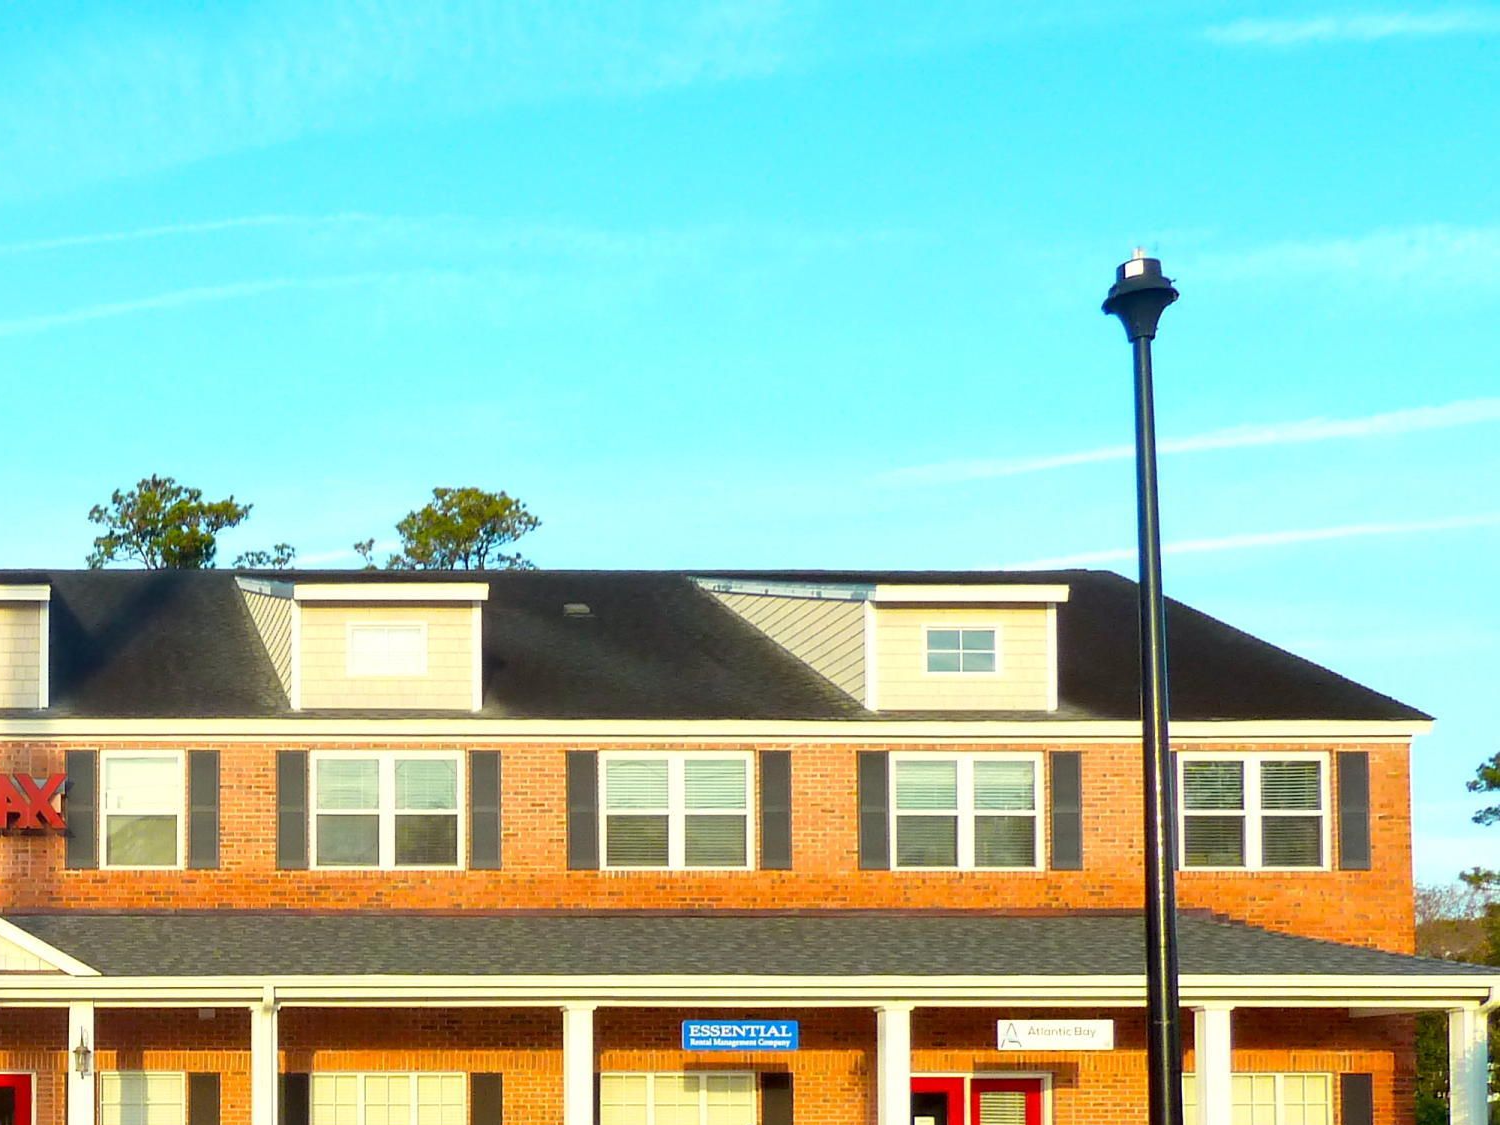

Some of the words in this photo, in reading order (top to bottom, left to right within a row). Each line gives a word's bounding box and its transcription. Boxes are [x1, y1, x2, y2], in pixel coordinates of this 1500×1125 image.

[689, 1025, 792, 1037] ESSENTIAL
[1028, 1026, 1072, 1037] Atlantic
[1074, 1026, 1097, 1038] Bay
[713, 1038, 757, 1048] Management
[758, 1038, 791, 1048] Company
